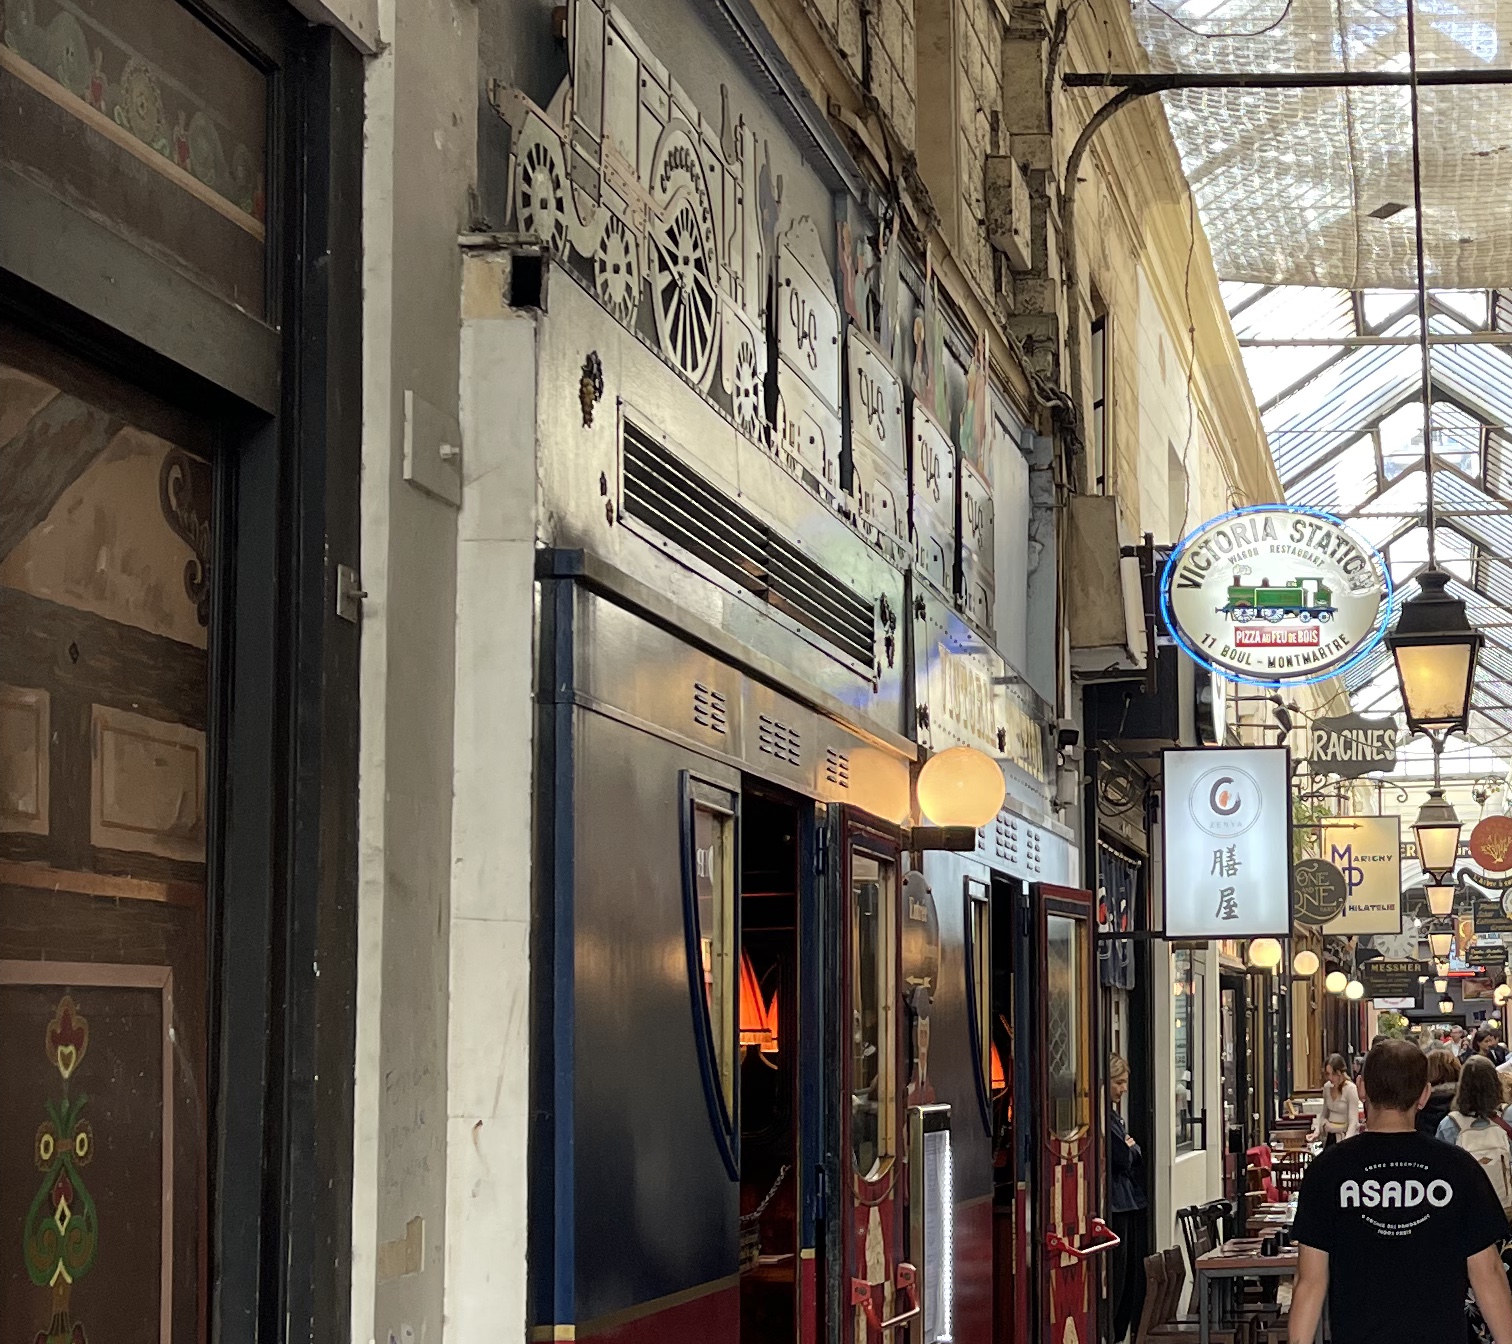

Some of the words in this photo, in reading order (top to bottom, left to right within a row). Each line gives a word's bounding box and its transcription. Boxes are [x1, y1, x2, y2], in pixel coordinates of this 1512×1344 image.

[1176, 516, 1278, 590] VICTORIA
[1290, 518, 1375, 591] STATION
[1270, 544, 1325, 567] RESTAURANT
[1236, 630, 1261, 644] PIZZA
[1272, 630, 1288, 644] FEU
[1297, 629, 1318, 643] BOIS
[1220, 644, 1251, 666] BOUL
[1267, 633, 1350, 669] MONTMARTRE
[1313, 729, 1396, 761] RACINES
[1210, 821, 1243, 829] ZENYA
[1295, 863, 1330, 887] ONE
[1370, 963, 1422, 972] MESSMER
[1340, 1178, 1454, 1208] ASADO
